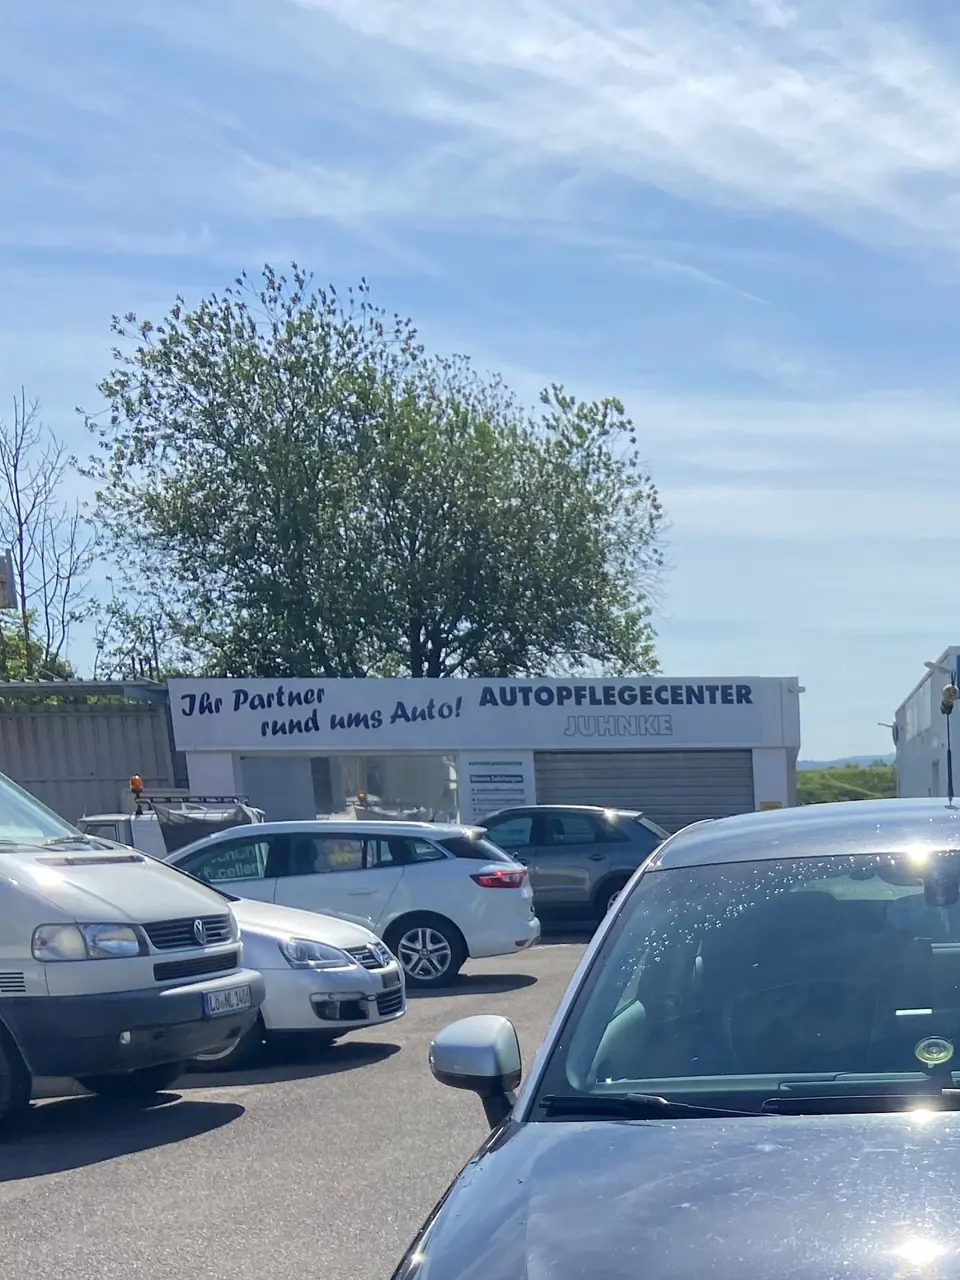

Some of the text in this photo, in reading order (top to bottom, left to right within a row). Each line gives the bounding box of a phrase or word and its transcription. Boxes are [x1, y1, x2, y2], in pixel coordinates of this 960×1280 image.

[181, 685, 325, 716] Ihr Partner
[479, 685, 753, 706] AUTOPFLEGECENTER
[261, 696, 462, 736] rund ums Auto!
[564, 714, 673, 737] JUHNKE
